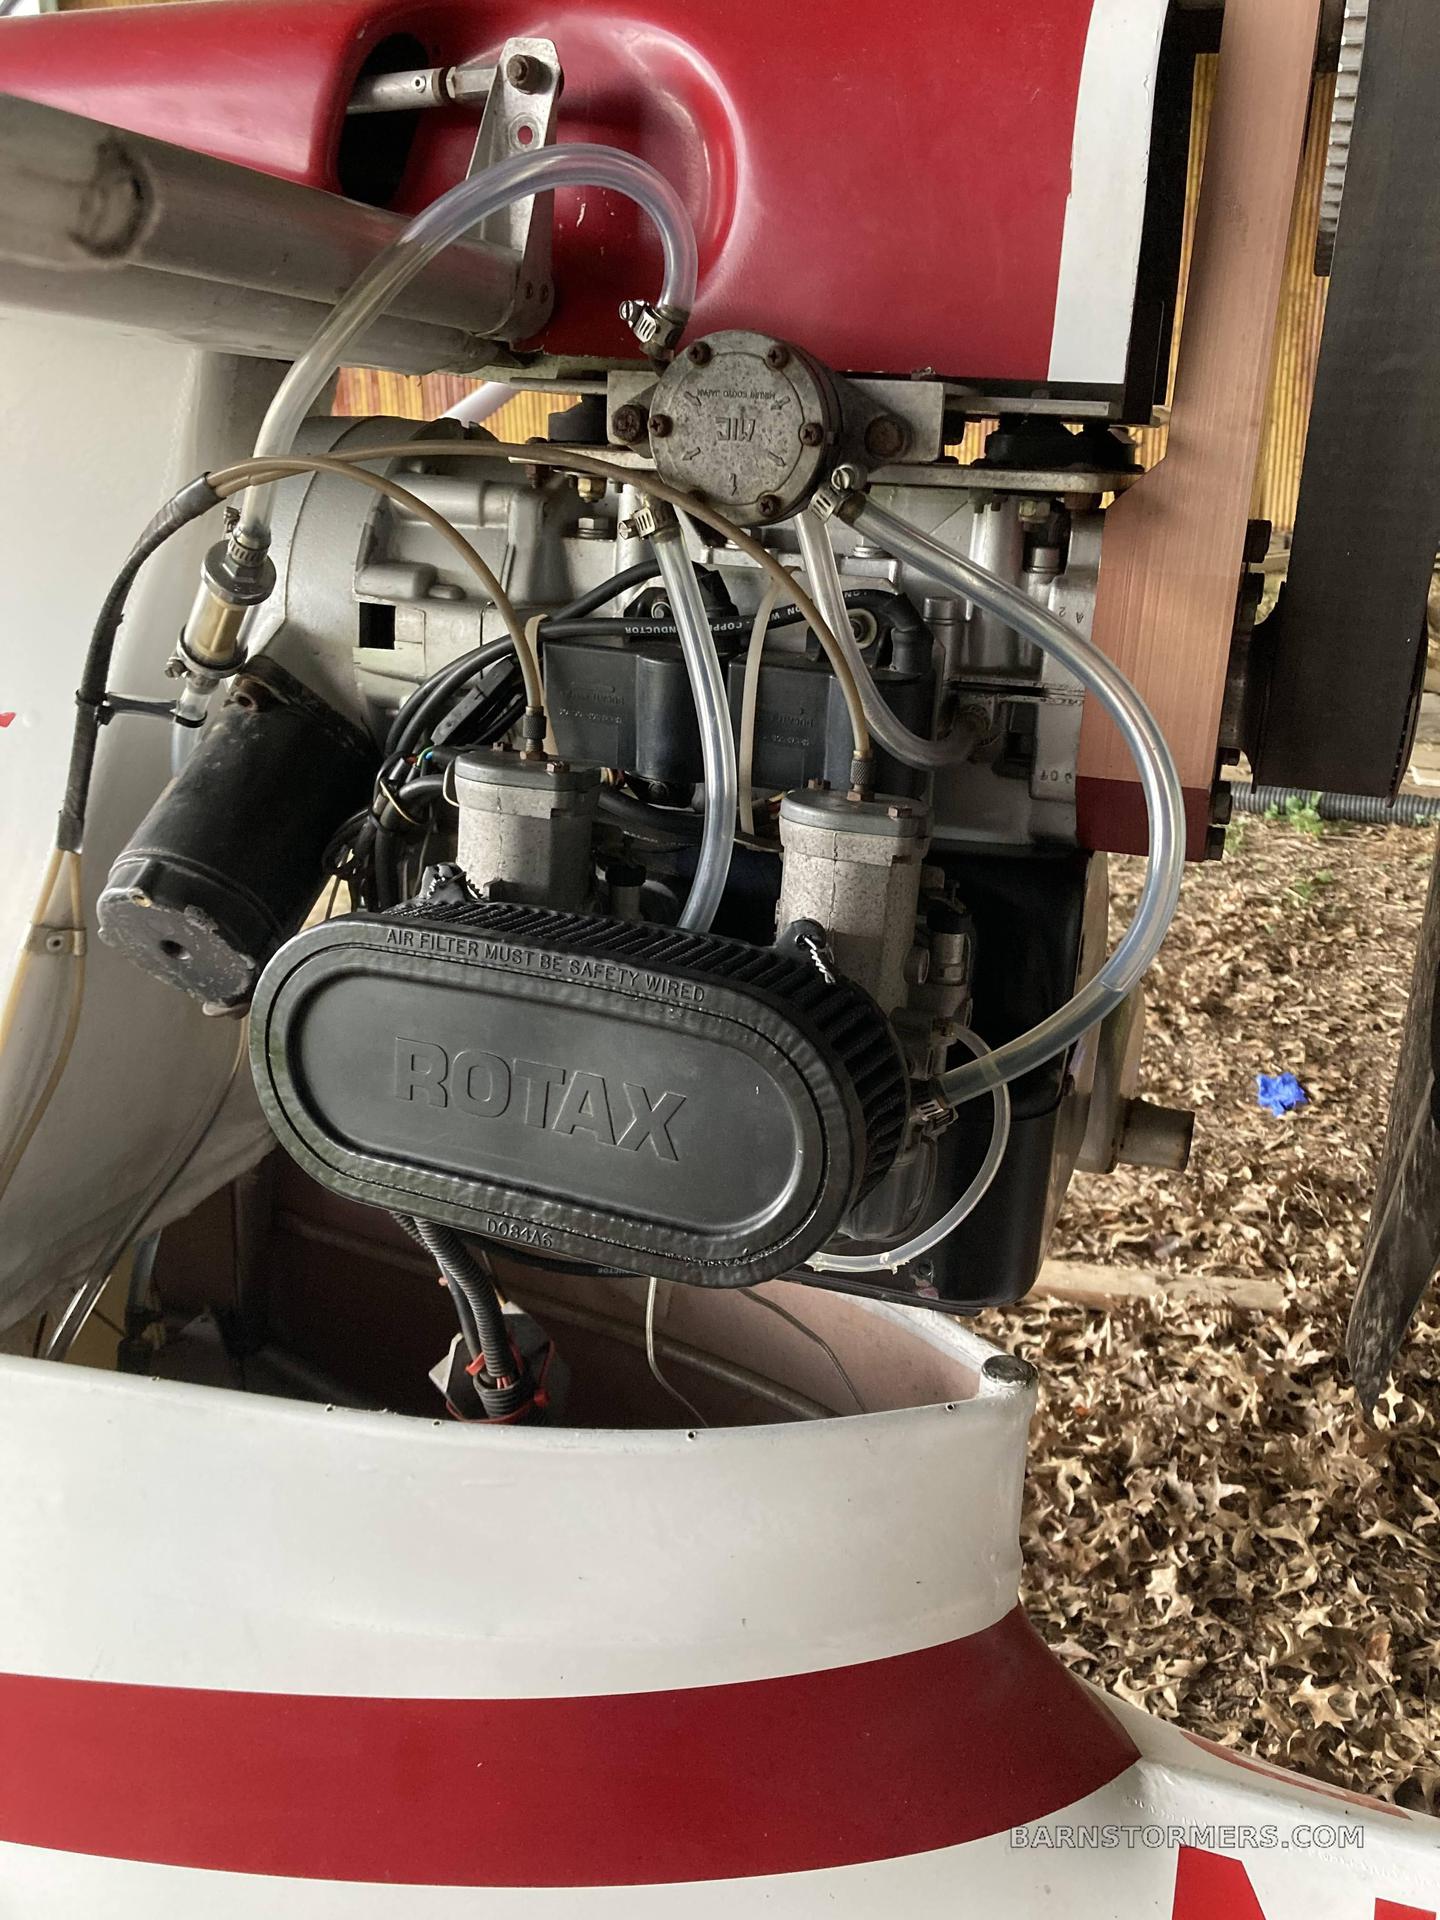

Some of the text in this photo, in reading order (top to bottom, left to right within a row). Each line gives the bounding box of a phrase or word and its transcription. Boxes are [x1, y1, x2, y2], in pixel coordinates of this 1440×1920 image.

[624, 625, 677, 634] NDUCTOR
[386, 928, 706, 1003] AIR FILTER MUST BE SAFETY WIRED
[393, 1036, 688, 1162] ROTAX
